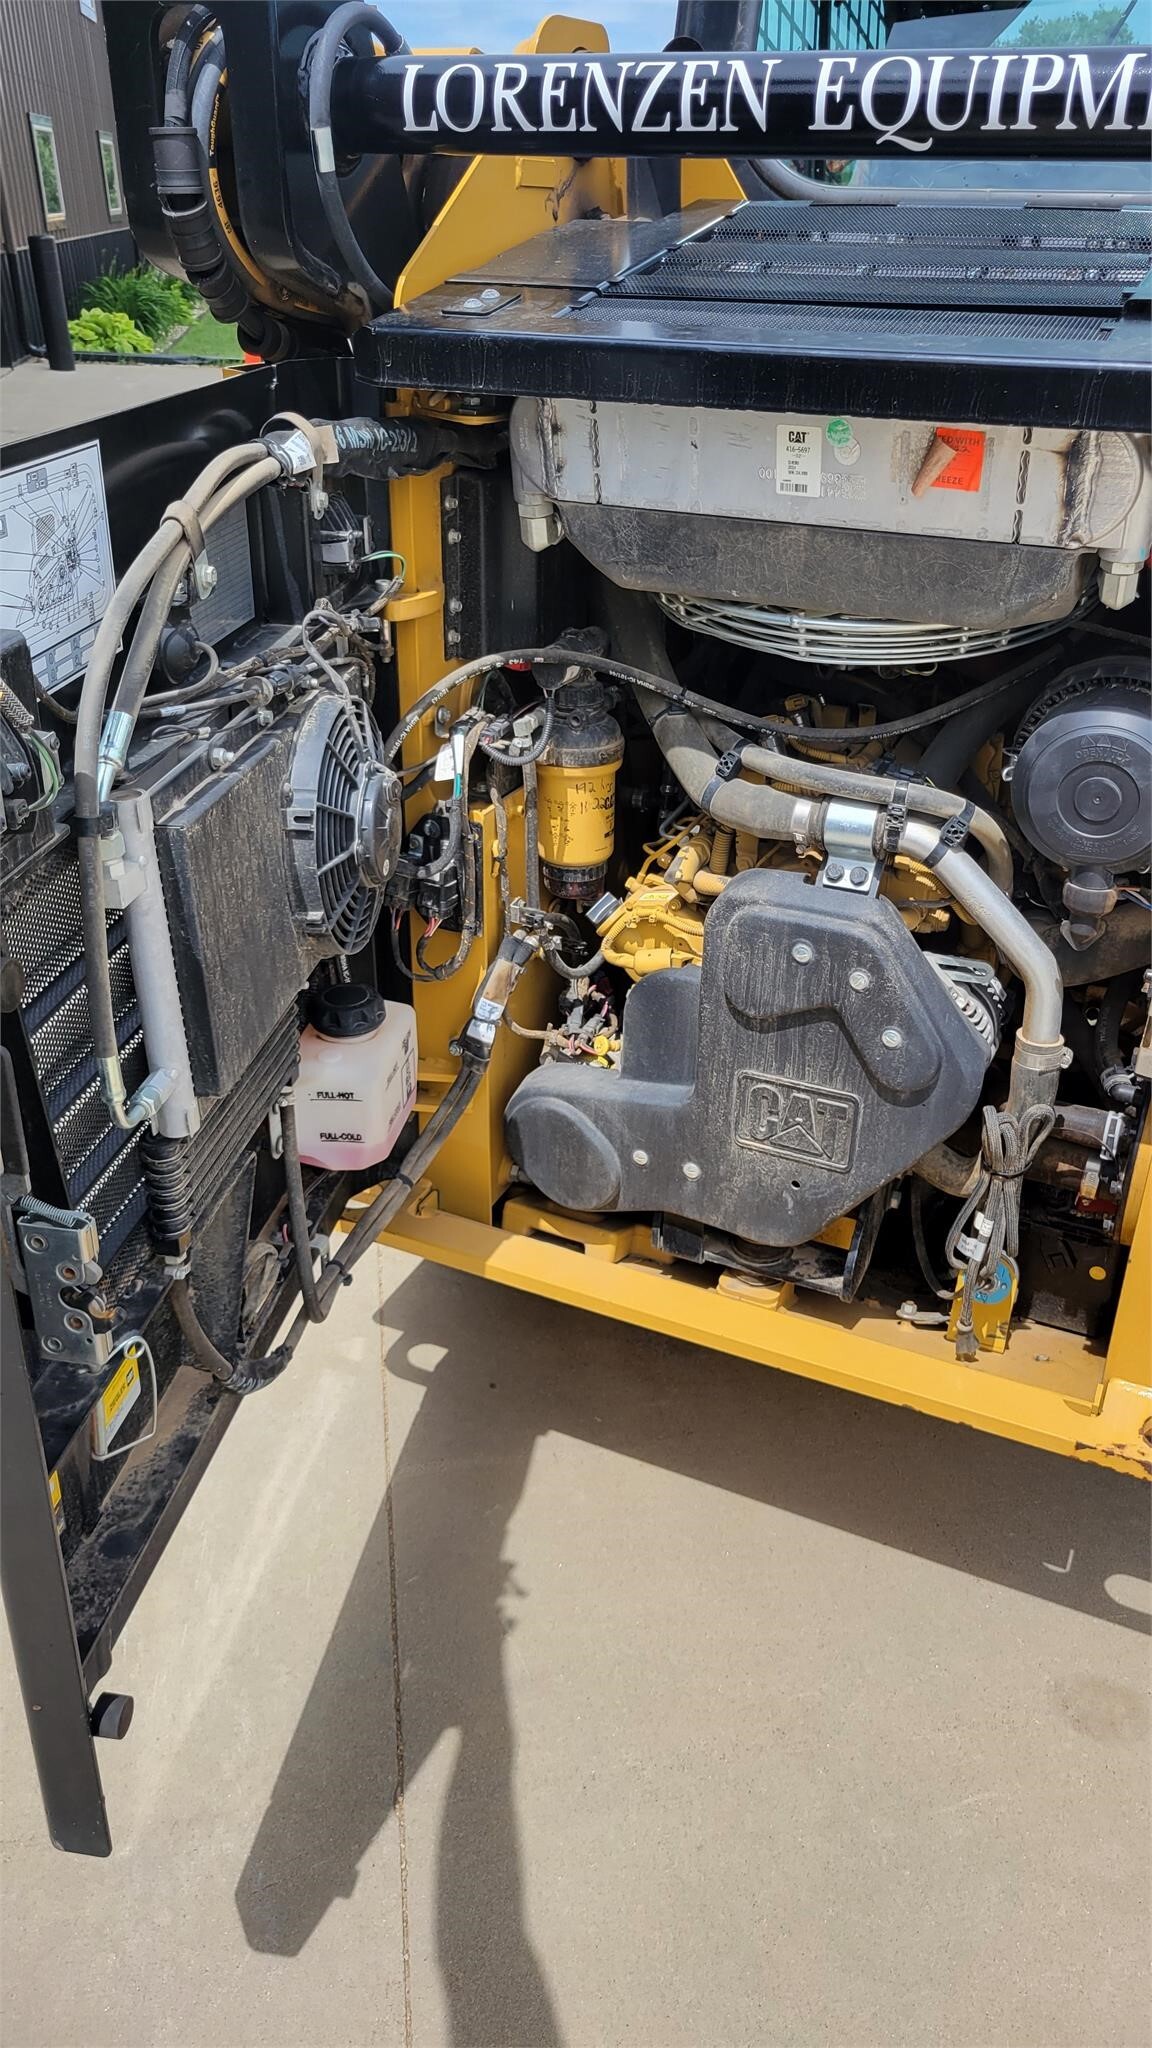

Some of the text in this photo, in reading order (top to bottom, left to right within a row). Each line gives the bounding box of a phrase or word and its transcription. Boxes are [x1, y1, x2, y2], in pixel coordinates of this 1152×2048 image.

[402, 52, 1152, 153] LORENZEN EQUIPM
[788, 431, 807, 444] CAT
[954, 437, 980, 447] WITH
[316, 1091, 355, 1100] FULL-HOT
[747, 1082, 850, 1167] CAT
[319, 1132, 363, 1141] FULL-COLD
